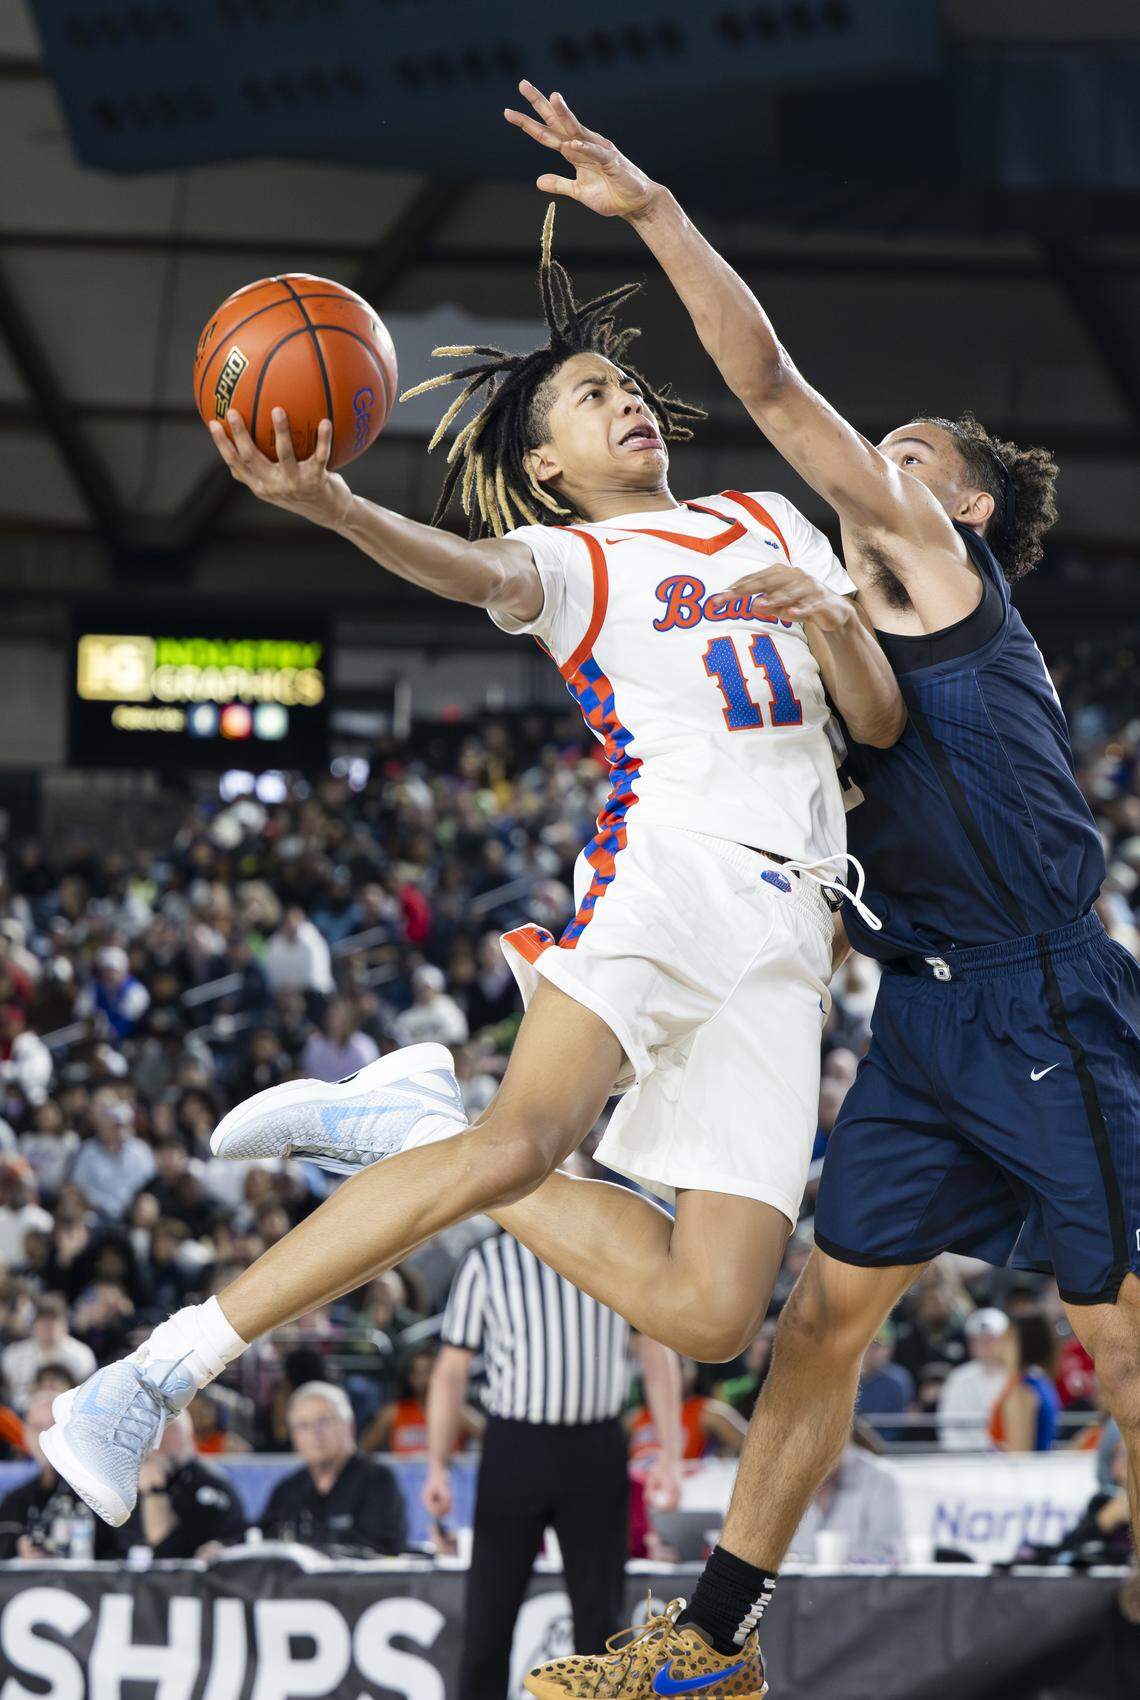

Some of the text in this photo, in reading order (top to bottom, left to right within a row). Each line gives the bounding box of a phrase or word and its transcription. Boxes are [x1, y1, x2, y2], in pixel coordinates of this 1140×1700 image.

[653, 574, 793, 632] Bea
[702, 634, 803, 731] 11
[932, 1500, 1084, 1542] North
[1, 1586, 446, 1700] SHIPS
